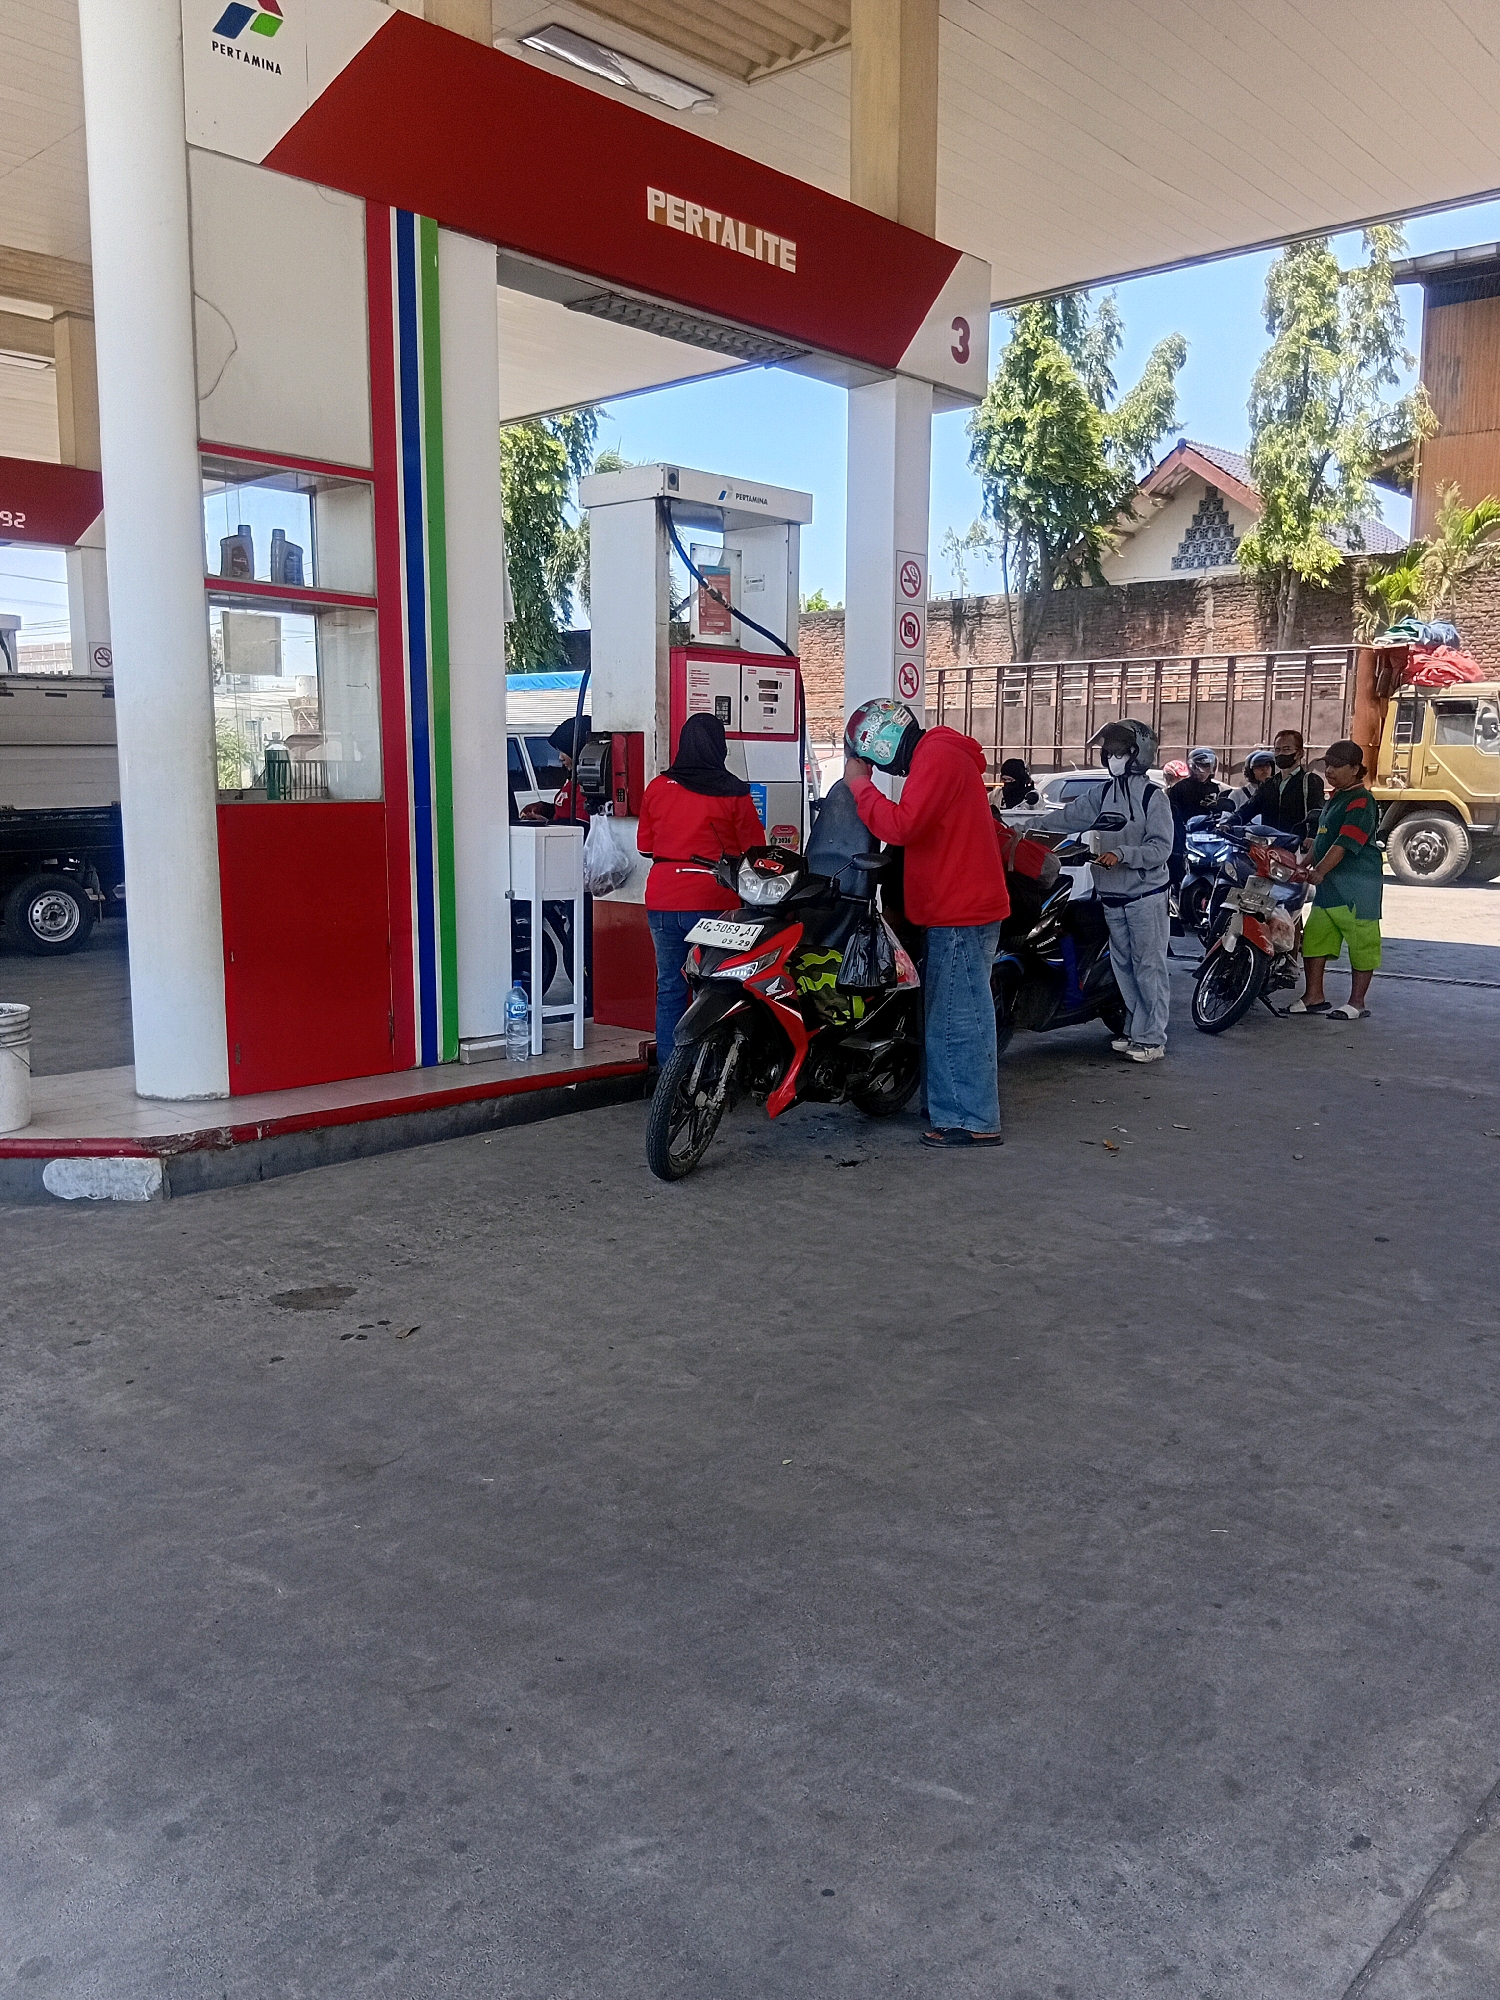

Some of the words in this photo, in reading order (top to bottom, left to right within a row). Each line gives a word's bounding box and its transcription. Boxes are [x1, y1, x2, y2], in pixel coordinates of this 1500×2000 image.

[211, 40, 282, 75] PERTAMINA
[647, 185, 797, 274] PERTALITE
[950, 316, 970, 364] 3
[735, 492, 768, 505] PERTAMINA
[0, 510, 26, 529] 92
[697, 921, 711, 930] AG
[714, 922, 740, 935] 5069
[743, 926, 759, 937] AI
[721, 938, 751, 947] 09-29
